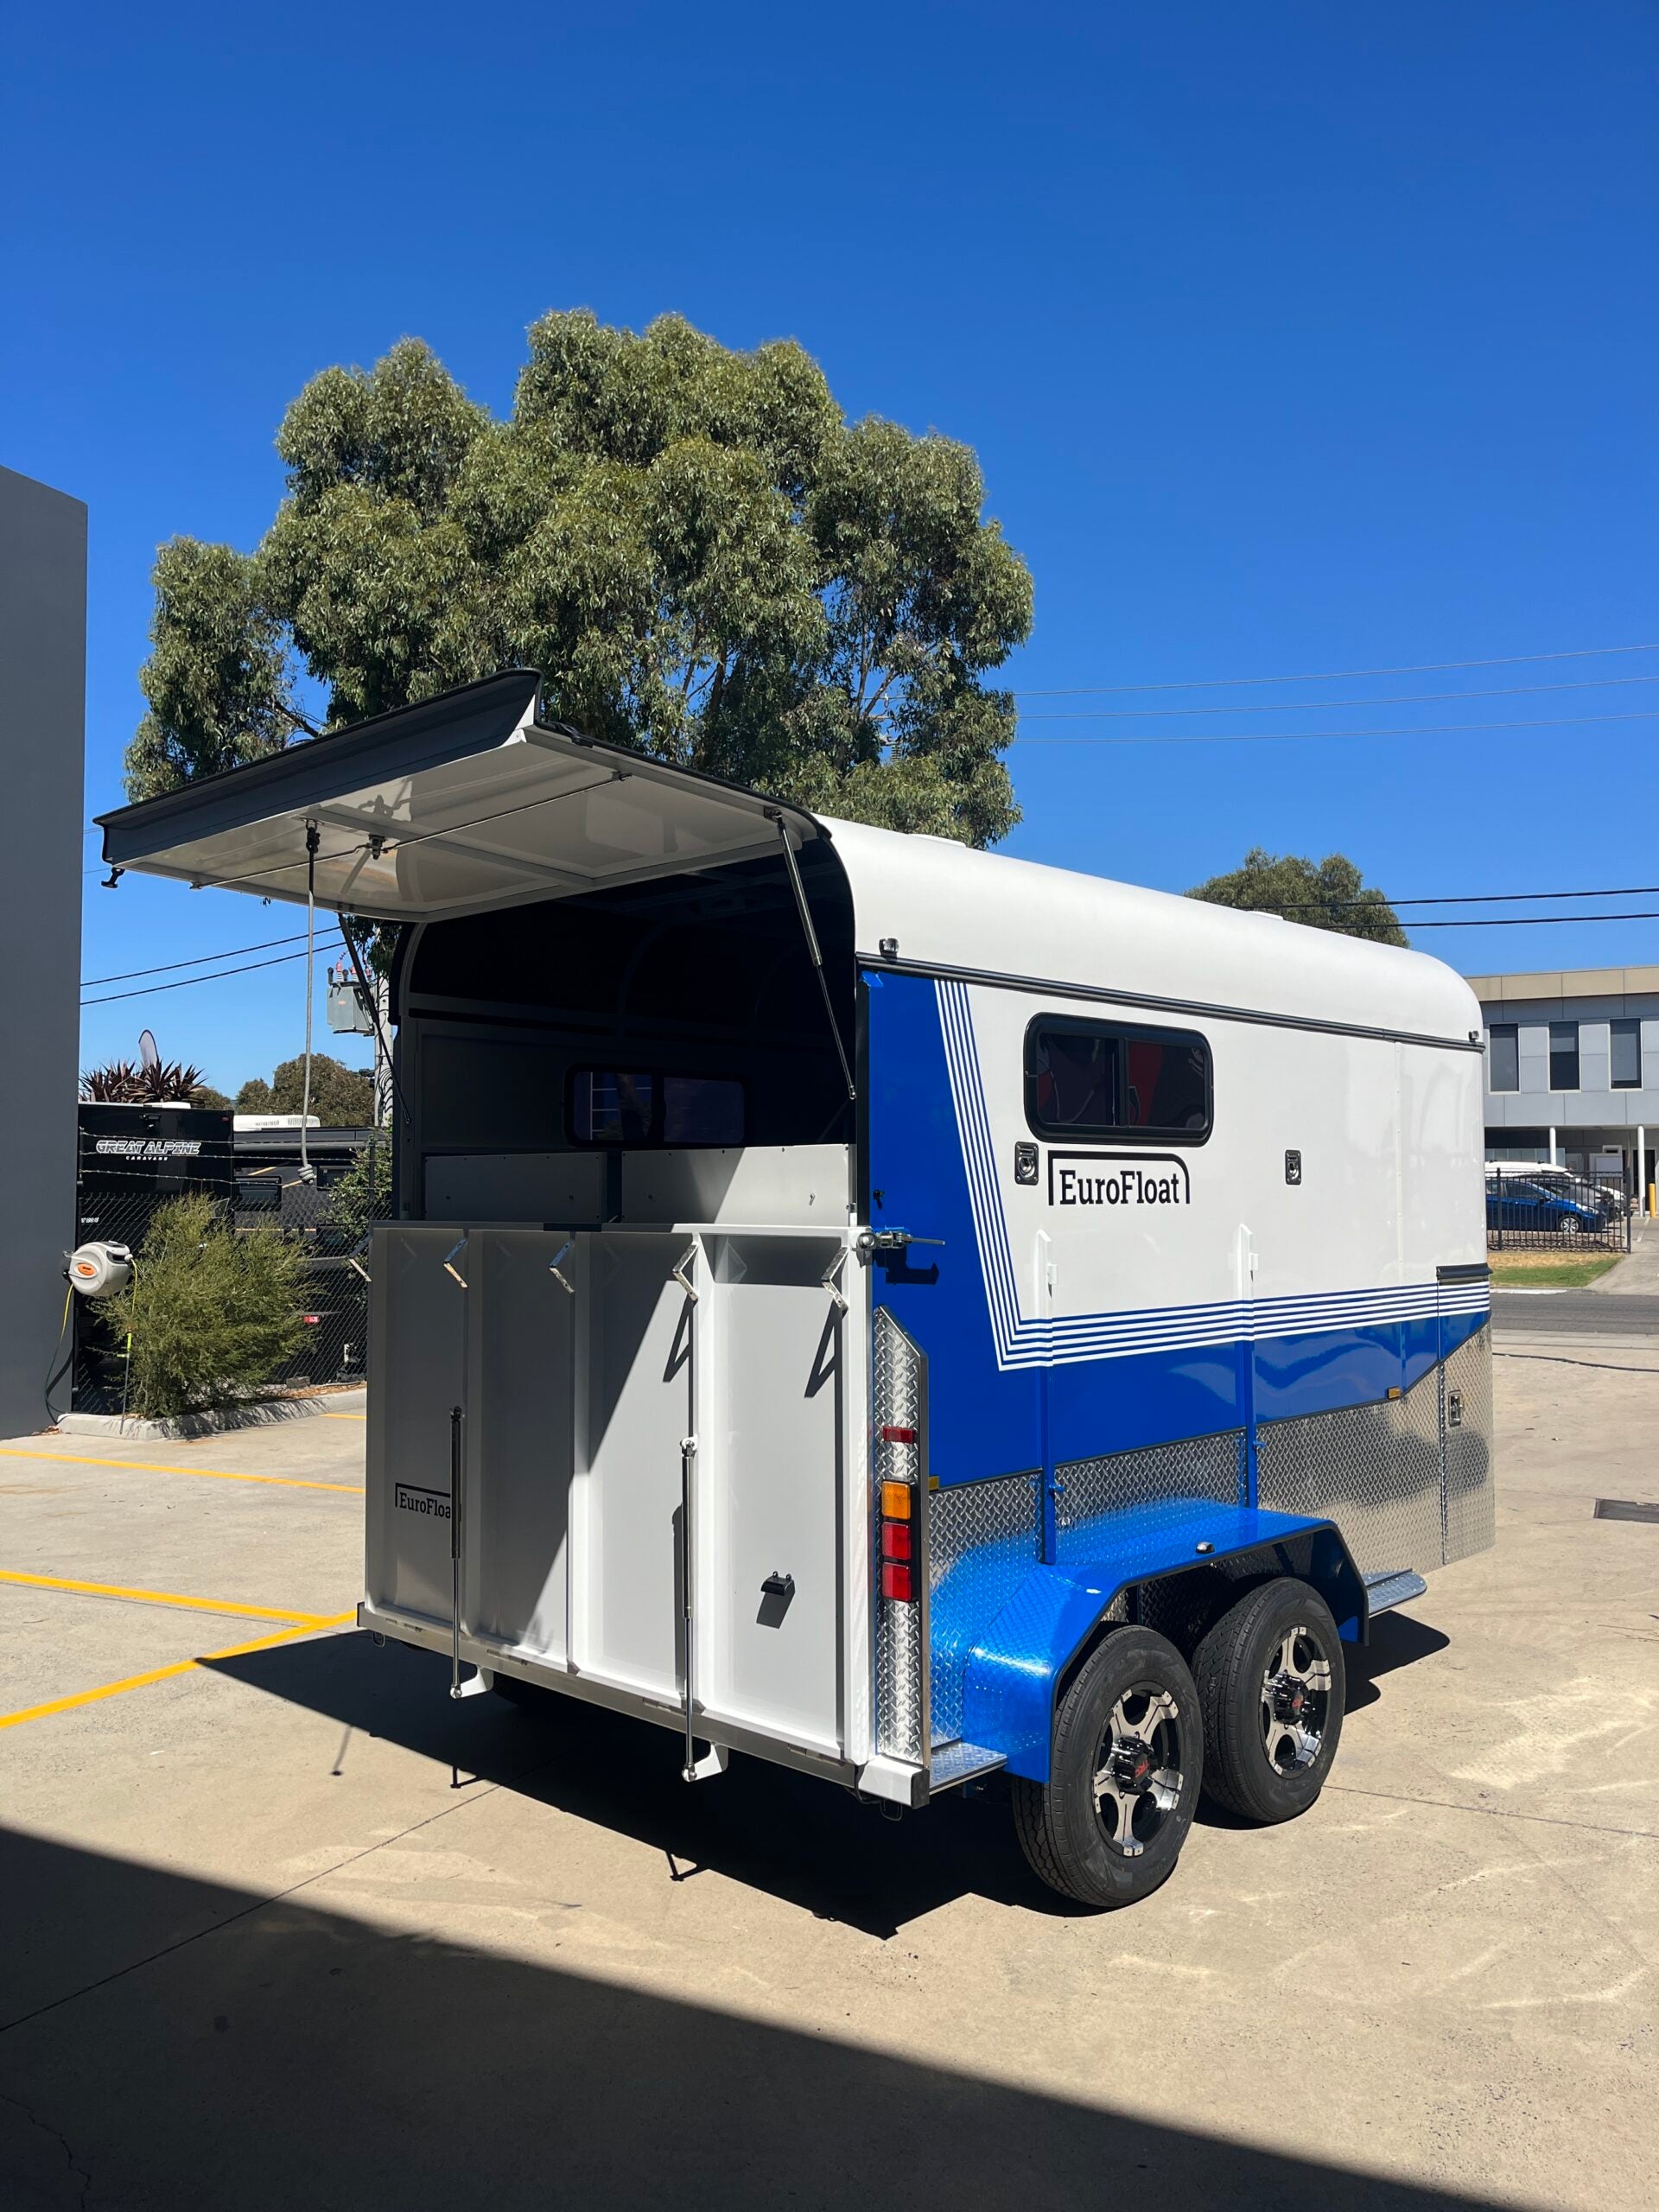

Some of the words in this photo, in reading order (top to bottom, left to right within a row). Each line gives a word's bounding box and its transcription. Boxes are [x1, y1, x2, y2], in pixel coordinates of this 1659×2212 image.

[96, 1140, 145, 1154] GREAT
[143, 1141, 201, 1155] ALPINE
[1059, 1169, 1179, 1205] EuroFloat
[399, 1491, 451, 1519] EuroFloa
